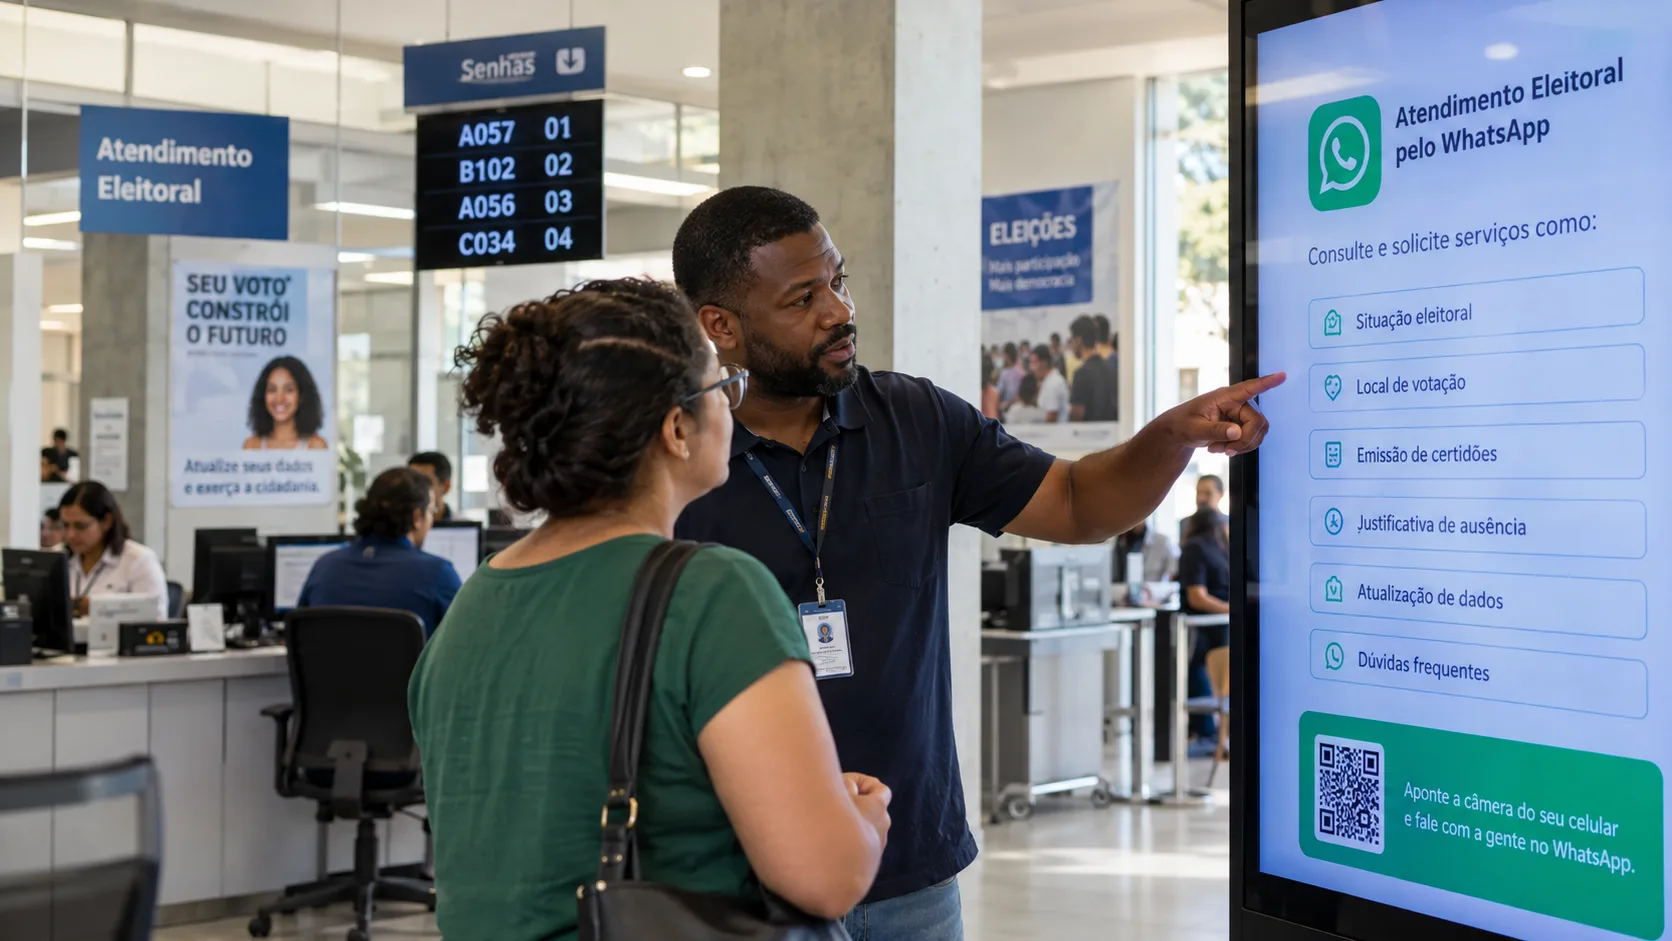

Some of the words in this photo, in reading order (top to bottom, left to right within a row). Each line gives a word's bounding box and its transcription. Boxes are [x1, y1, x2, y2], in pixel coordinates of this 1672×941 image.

[461, 54, 536, 81] Senhas
[1395, 84, 1525, 128] Atendimento
[1531, 56, 1623, 100] Eleitoral
[458, 120, 515, 148] A057
[544, 115, 571, 140] 01
[1396, 136, 1436, 168] pelo
[1441, 118, 1551, 154] WhatsApp
[96, 136, 253, 168] Atendimento
[459, 156, 516, 183] B102
[544, 152, 573, 177] 02
[97, 175, 201, 204] Eleitoral
[458, 193, 516, 220] A056
[544, 189, 573, 214] 03
[458, 229, 516, 256] C034
[544, 226, 573, 251] 04
[990, 212, 1077, 247] ELEIÇÕES
[1308, 240, 1374, 266] Consulte
[1378, 243, 1387, 256] e
[1392, 231, 1450, 255] solicite
[1455, 222, 1529, 247] serviços
[1535, 214, 1598, 237] como:
[187, 273, 227, 294] SEU
[187, 299, 289, 323] CONSTRÓI
[1356, 310, 1412, 331] Situação
[1416, 303, 1472, 324] eleitoral
[186, 325, 200, 344] O
[207, 325, 287, 346] FUTURO
[1356, 376, 1389, 395] Local
[1392, 376, 1409, 393] de
[1412, 374, 1466, 395] votação
[184, 458, 239, 473] Atualize
[243, 460, 271, 473] seus
[275, 459, 314, 473] dados
[1357, 446, 1408, 463] Emissão
[1411, 445, 1428, 462] de
[1431, 444, 1498, 462] certidões
[184, 483, 192, 494] e
[196, 482, 240, 497] exerça
[244, 483, 252, 494] a
[1357, 514, 1434, 534] Justificativa
[1438, 516, 1456, 533] de
[1460, 517, 1527, 536] ausência
[1357, 583, 1434, 607] Atualização
[1437, 588, 1455, 605] de
[1458, 590, 1504, 610] dados
[1358, 651, 1410, 672] Dúvidas
[1413, 656, 1490, 682] frequentes
[1404, 781, 1450, 804] Aponte
[1453, 793, 1460, 807] a
[1464, 793, 1513, 817] câmera
[1517, 802, 1536, 821] do
[1539, 809, 1564, 827] seu
[1568, 814, 1619, 837] celular
[1404, 813, 1411, 827] e
[1415, 811, 1438, 831] fale
[1442, 821, 1470, 839] com
[1474, 827, 1481, 841] a
[1486, 829, 1526, 850] gente
[1530, 838, 1549, 855] no
[1552, 839, 1636, 876] WhatsApp.
